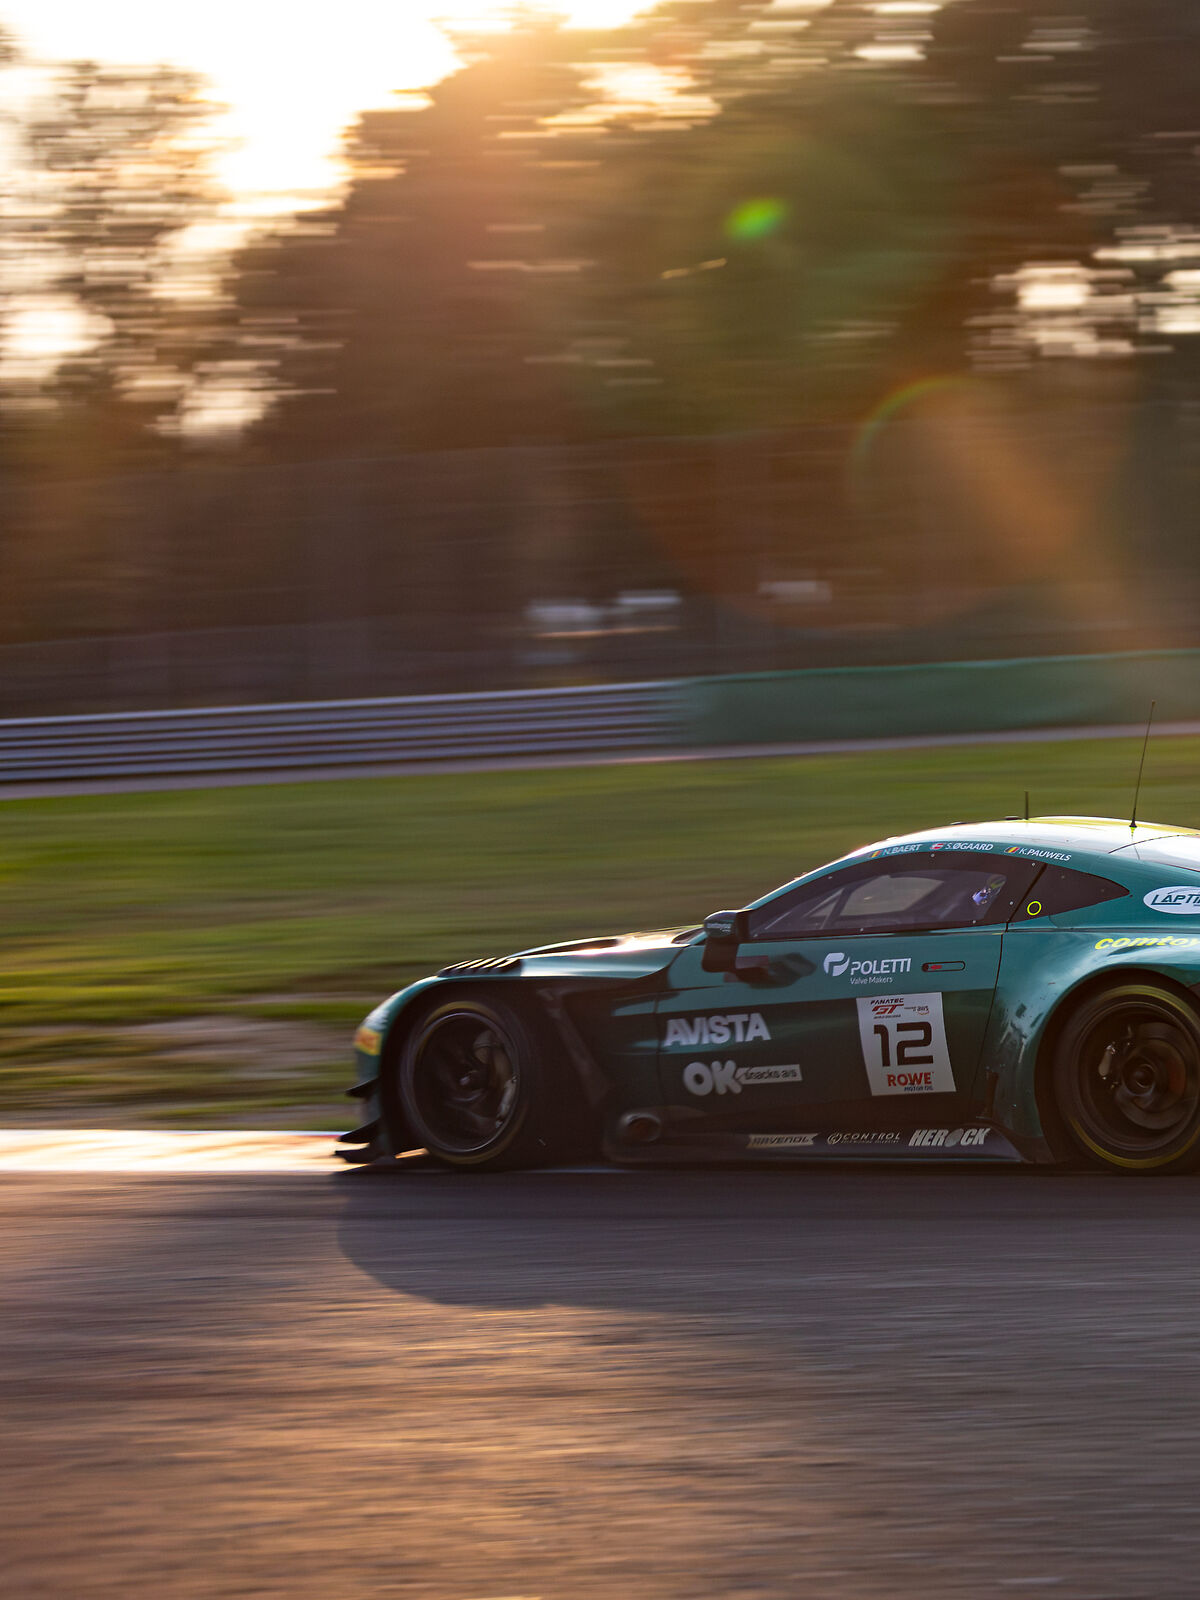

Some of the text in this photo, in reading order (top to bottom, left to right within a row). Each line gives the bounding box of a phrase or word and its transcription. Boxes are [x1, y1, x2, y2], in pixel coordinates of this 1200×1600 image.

[1019, 848, 1072, 862] K.PAUWELS
[850, 958, 912, 976] POLETTI
[850, 976, 893, 985] Valve Makers
[663, 1012, 771, 1047] AVISTA
[873, 1021, 934, 1067] 12
[683, 1059, 742, 1096] OK
[887, 1072, 932, 1087] ROWE
